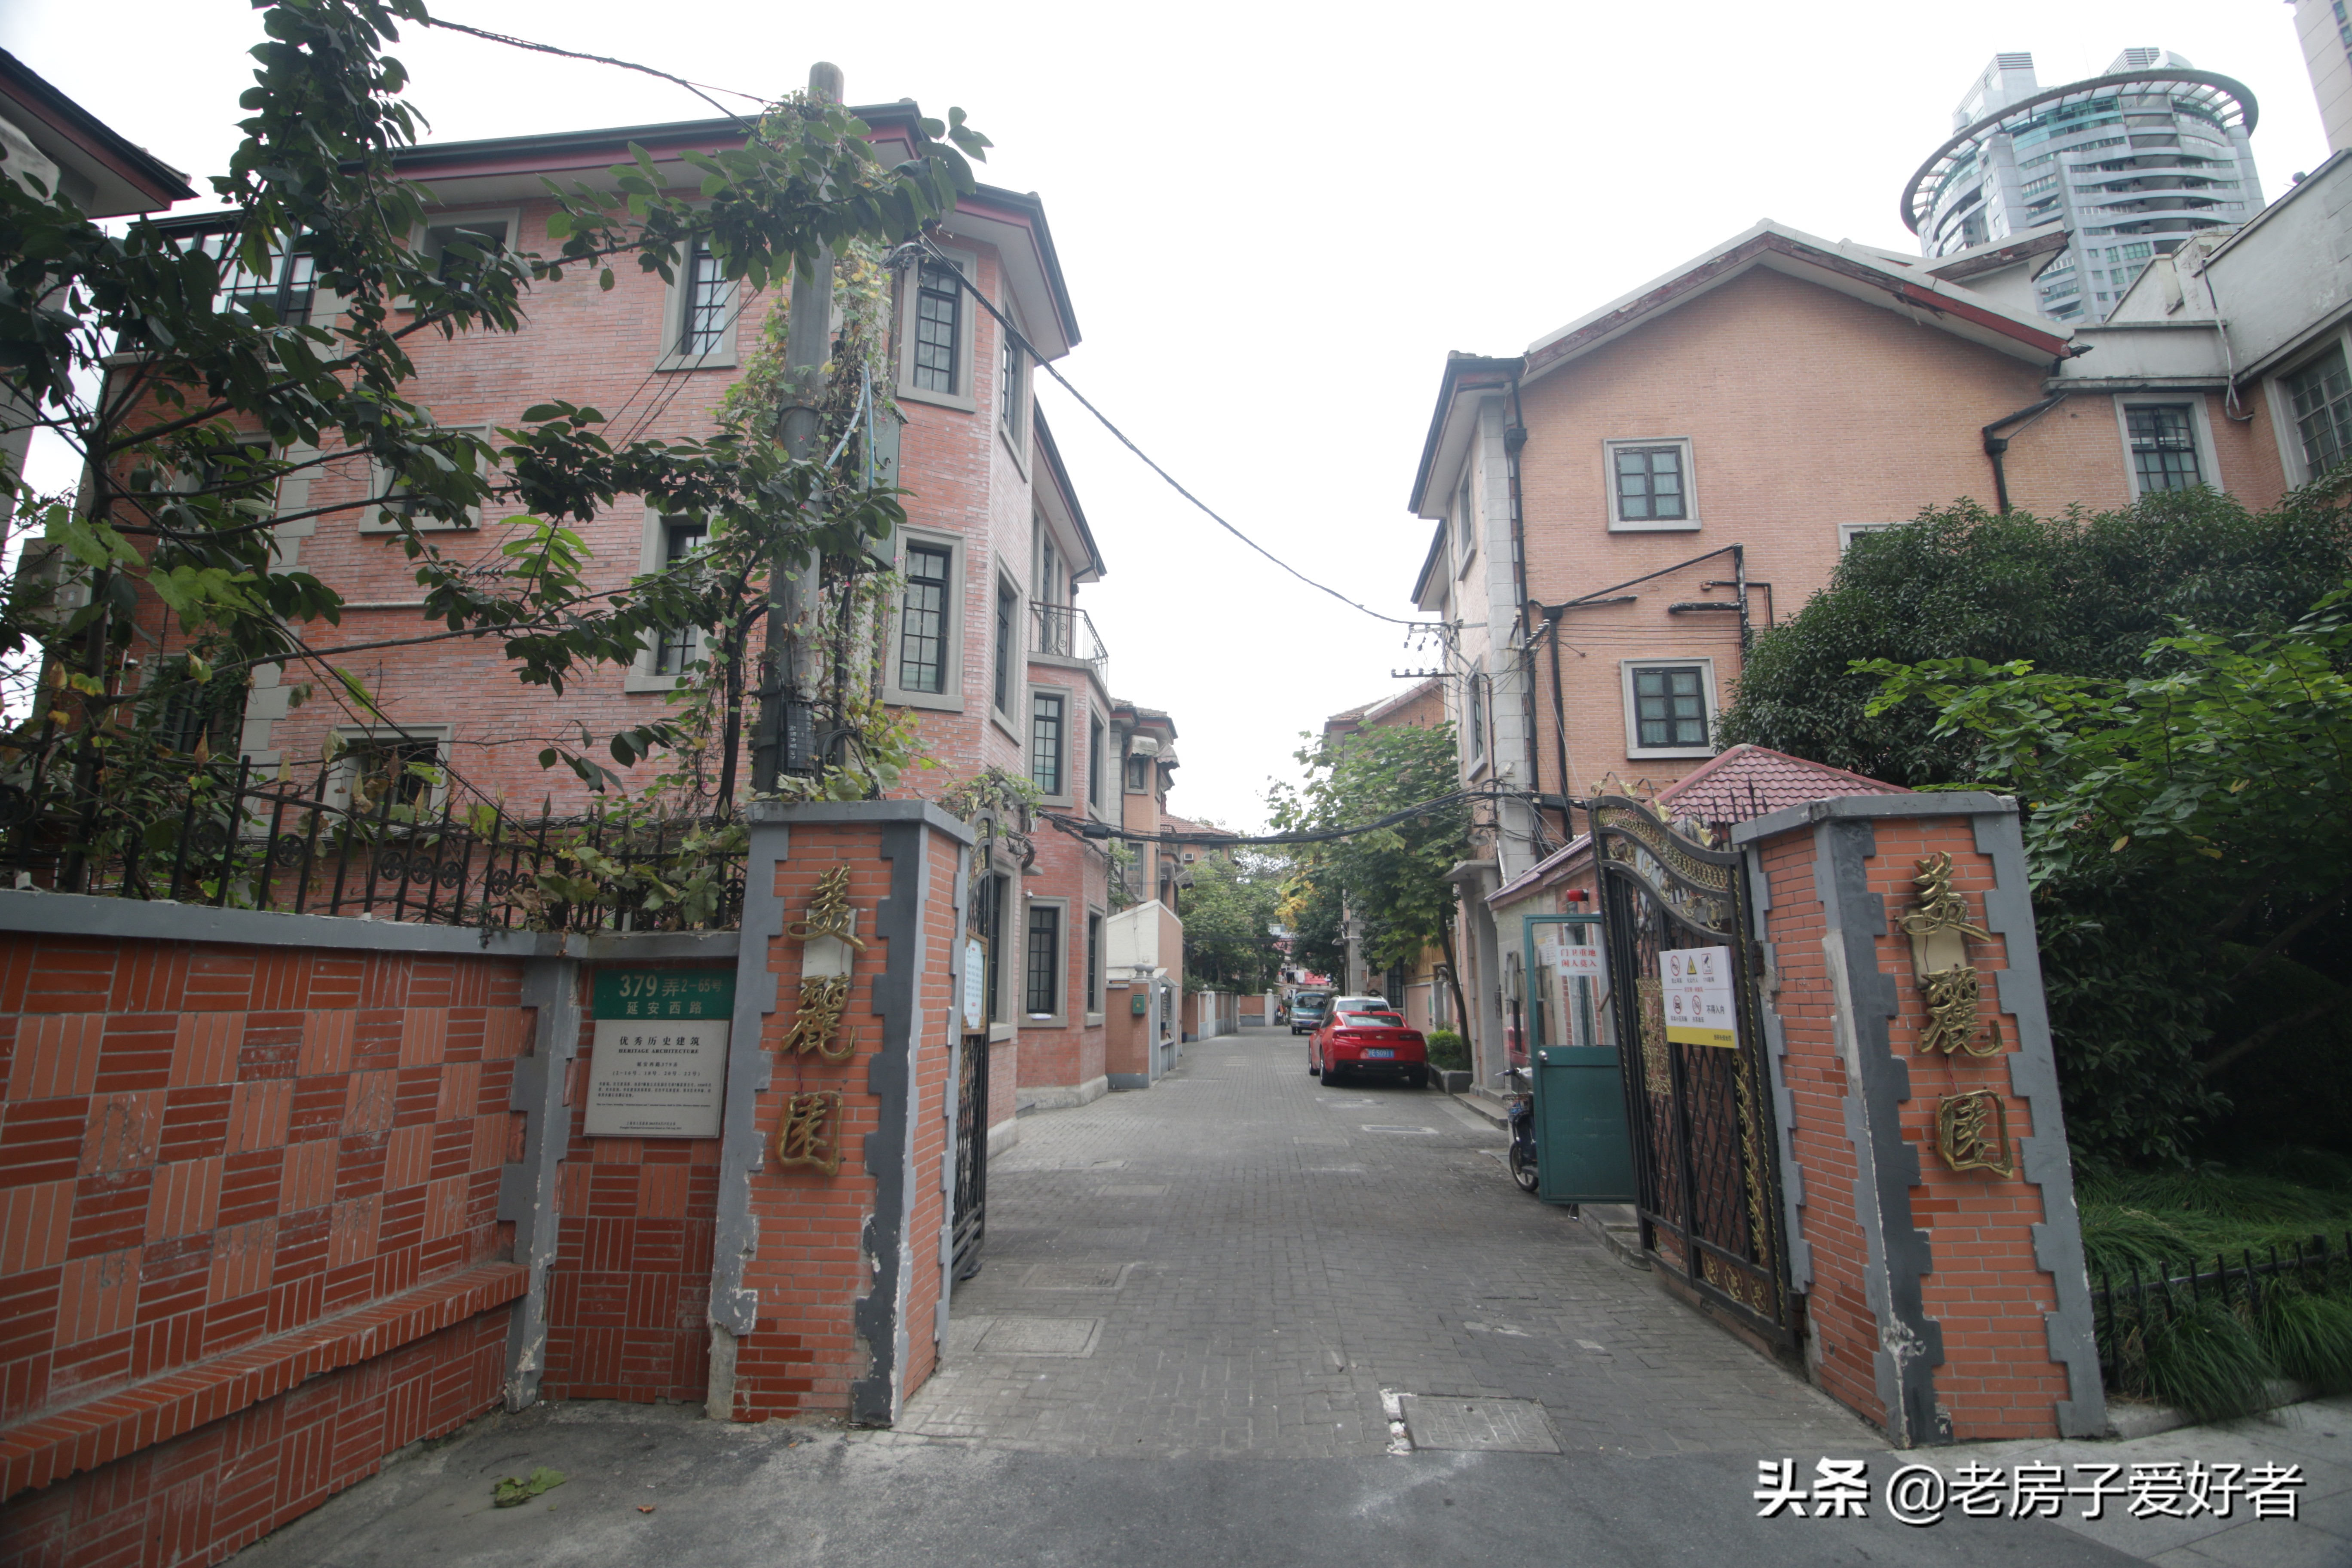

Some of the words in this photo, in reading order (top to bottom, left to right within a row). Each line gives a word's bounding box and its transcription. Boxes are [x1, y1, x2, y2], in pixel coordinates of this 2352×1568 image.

[626, 1001, 702, 1015] 延安西路
[1706, 1004, 1725, 1015] 不得入内
[619, 1036, 700, 1046] 优秀历史建筑
